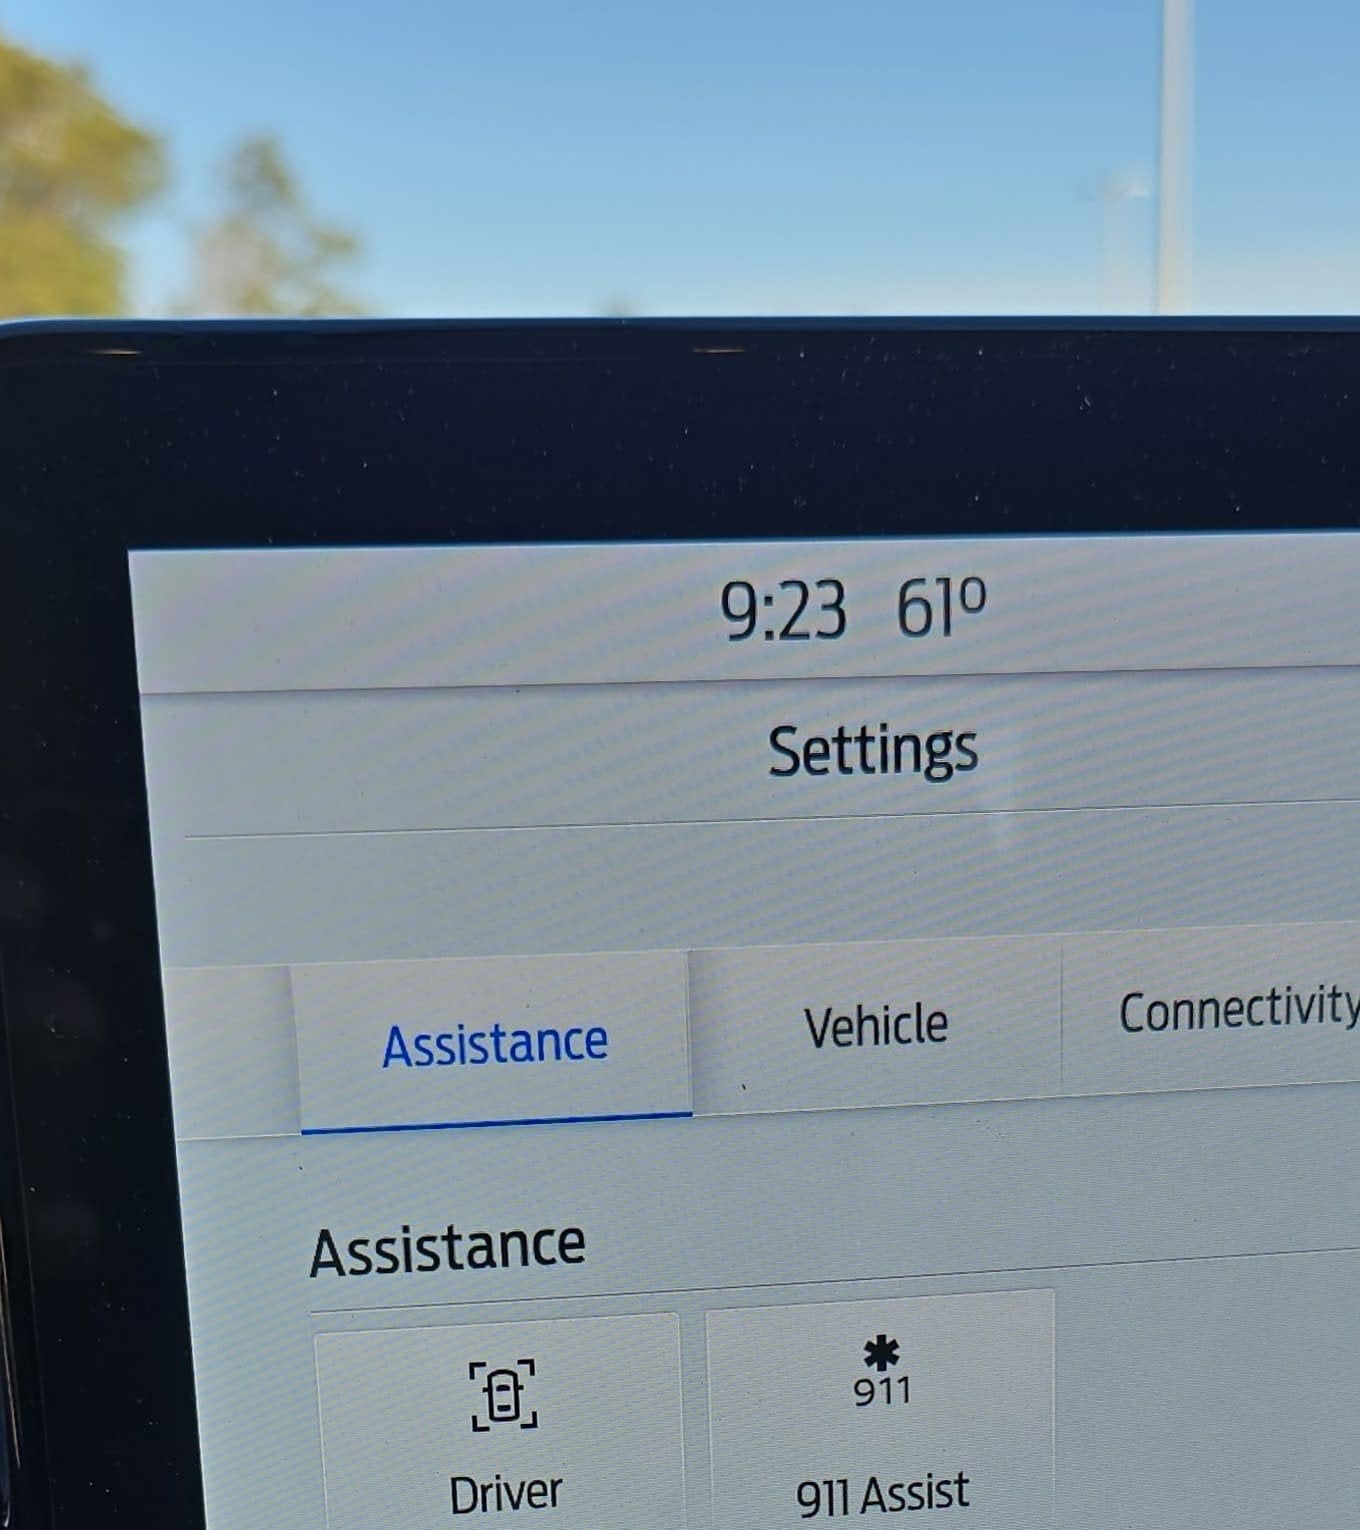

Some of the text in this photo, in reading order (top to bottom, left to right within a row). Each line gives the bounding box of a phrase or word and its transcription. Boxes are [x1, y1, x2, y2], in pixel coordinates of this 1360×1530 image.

[720, 576, 848, 643] 9:23
[768, 720, 980, 784] Settings
[381, 1021, 609, 1070] Assistance
[803, 999, 950, 1050] Vehicle
[308, 1222, 587, 1279] Assistance
[852, 1373, 911, 1409] 911
[449, 1473, 565, 1516] Driver
[795, 1469, 971, 1520] 911 Assist
